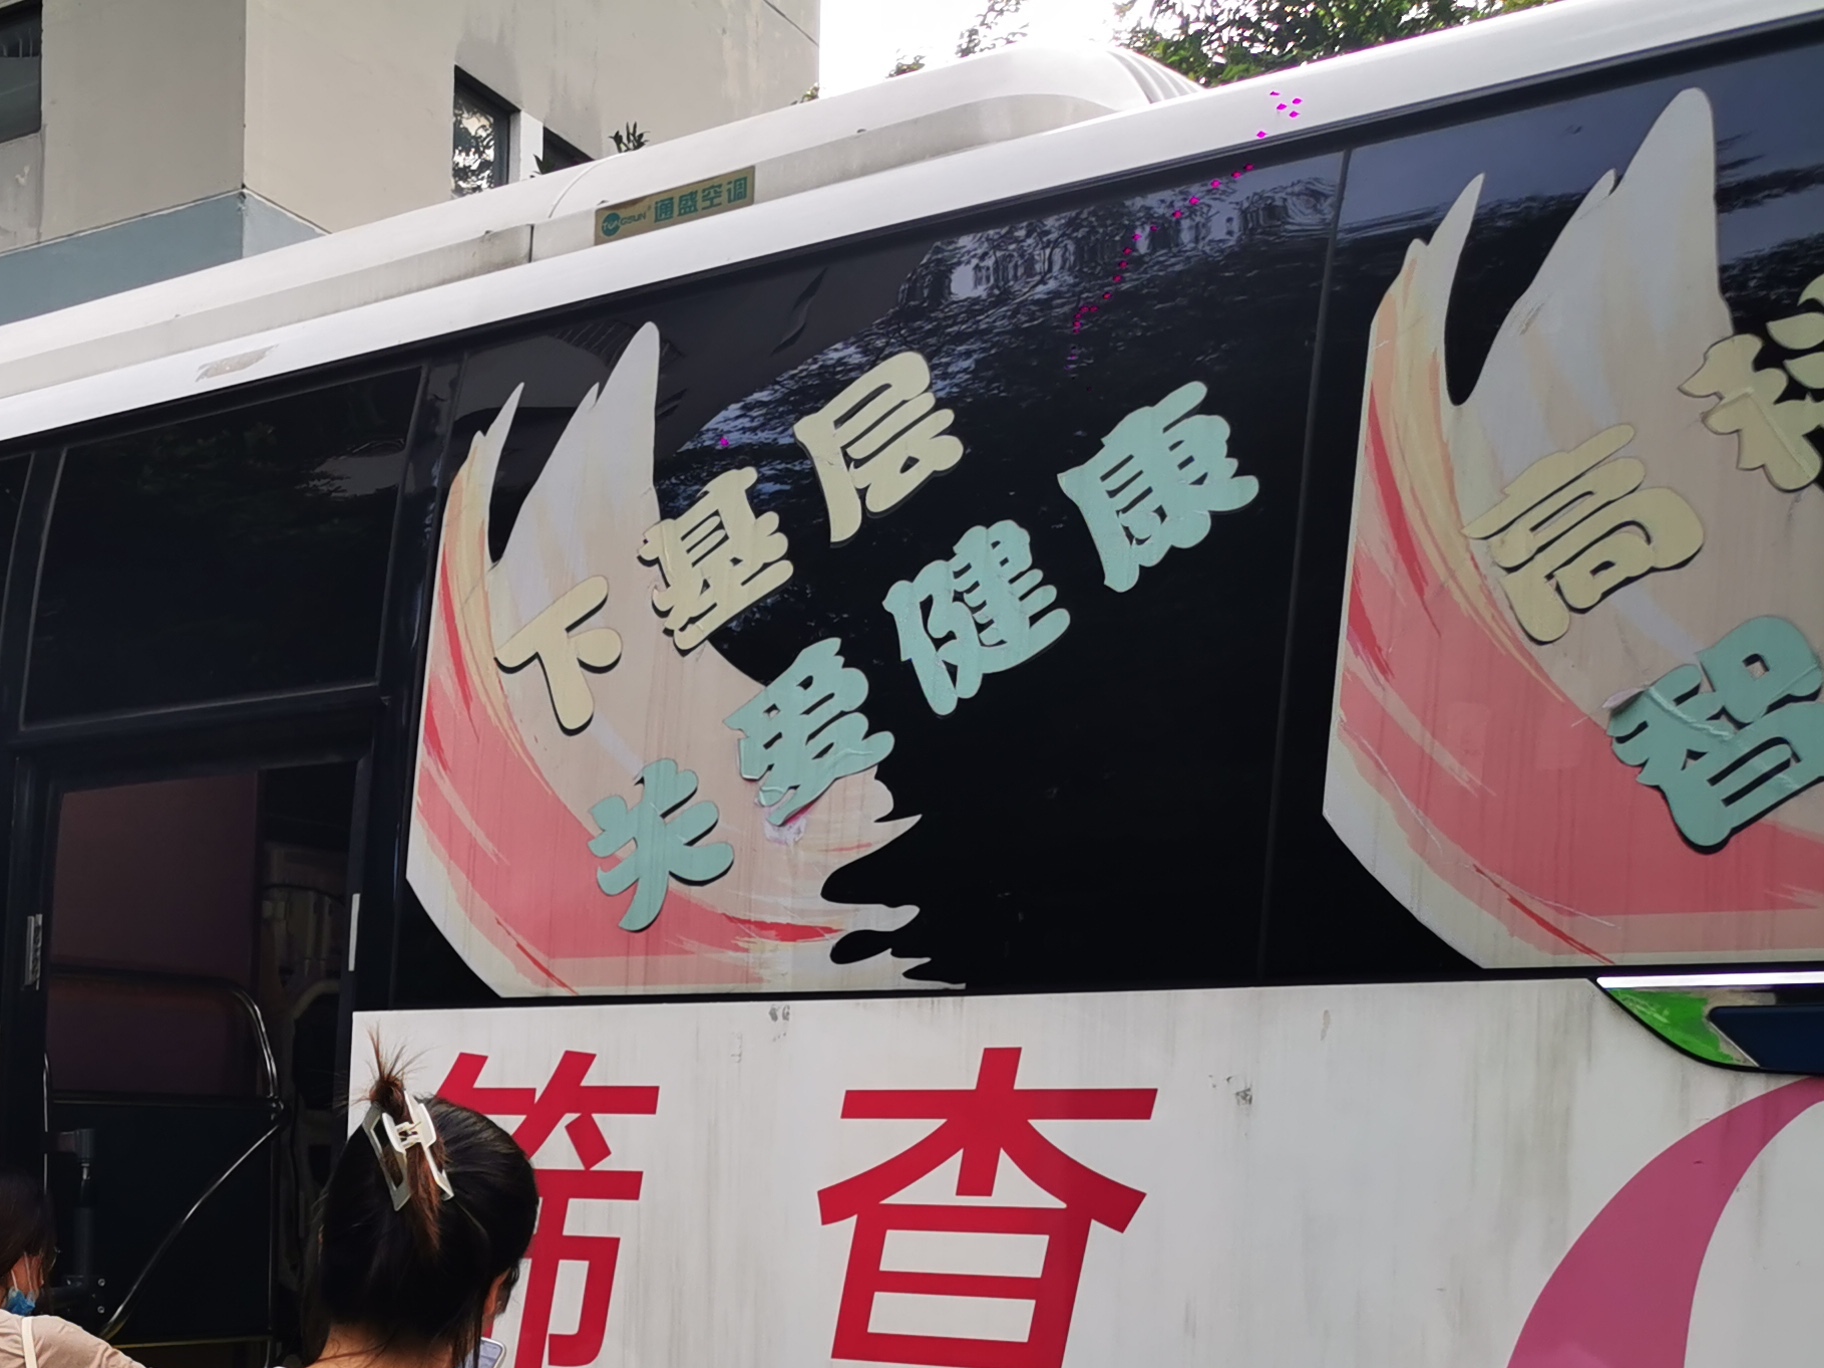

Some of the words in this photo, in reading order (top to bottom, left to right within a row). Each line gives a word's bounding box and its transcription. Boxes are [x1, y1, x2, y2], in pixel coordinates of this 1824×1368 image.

[654, 176, 749, 224] 通盛空调
[494, 351, 965, 736] 下基层
[586, 380, 1260, 934] 关爱健康
